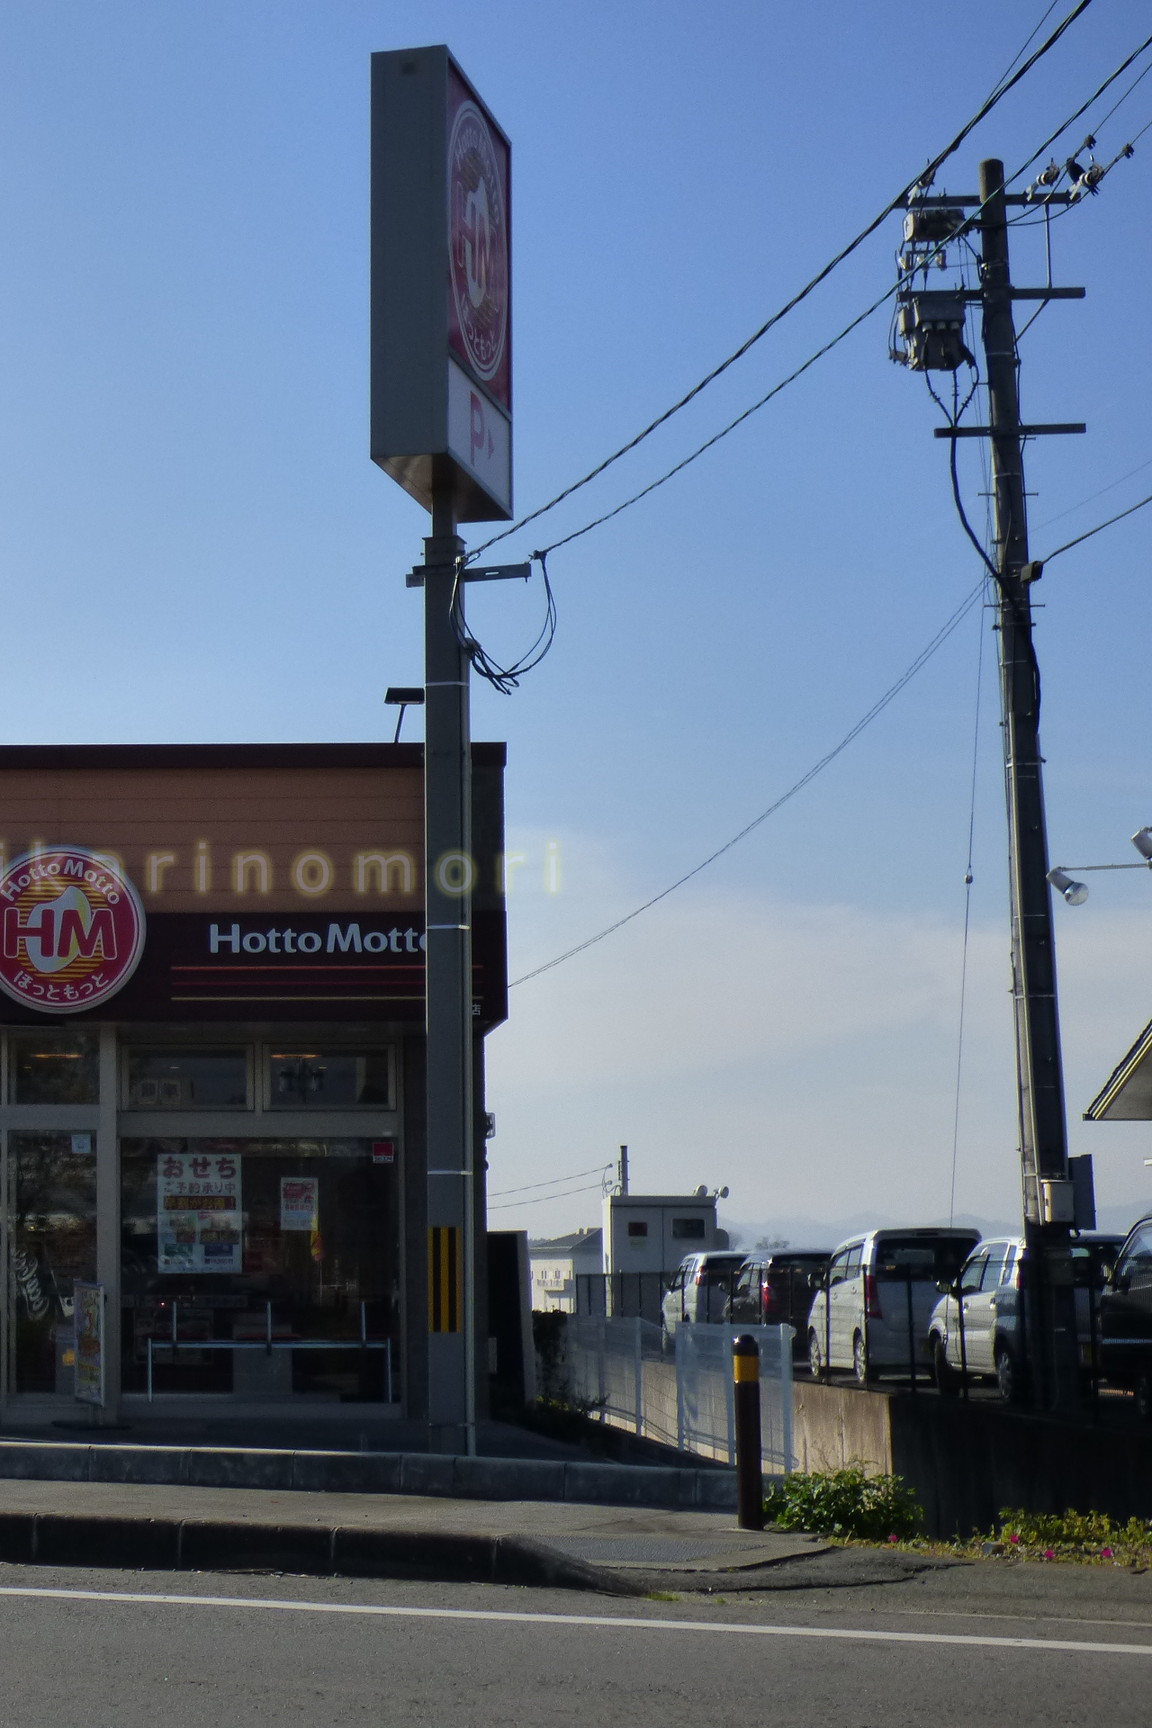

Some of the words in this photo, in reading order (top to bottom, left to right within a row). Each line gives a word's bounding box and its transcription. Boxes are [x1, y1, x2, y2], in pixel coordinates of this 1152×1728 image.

[470, 391, 484, 467] P
[3, 906, 118, 960] HM
[209, 923, 427, 953] HottoMott
[13, 970, 109, 1000] ほっともっと
[163, 1156, 237, 1179] おせち
[163, 1181, 237, 1194] ご予約承り中
